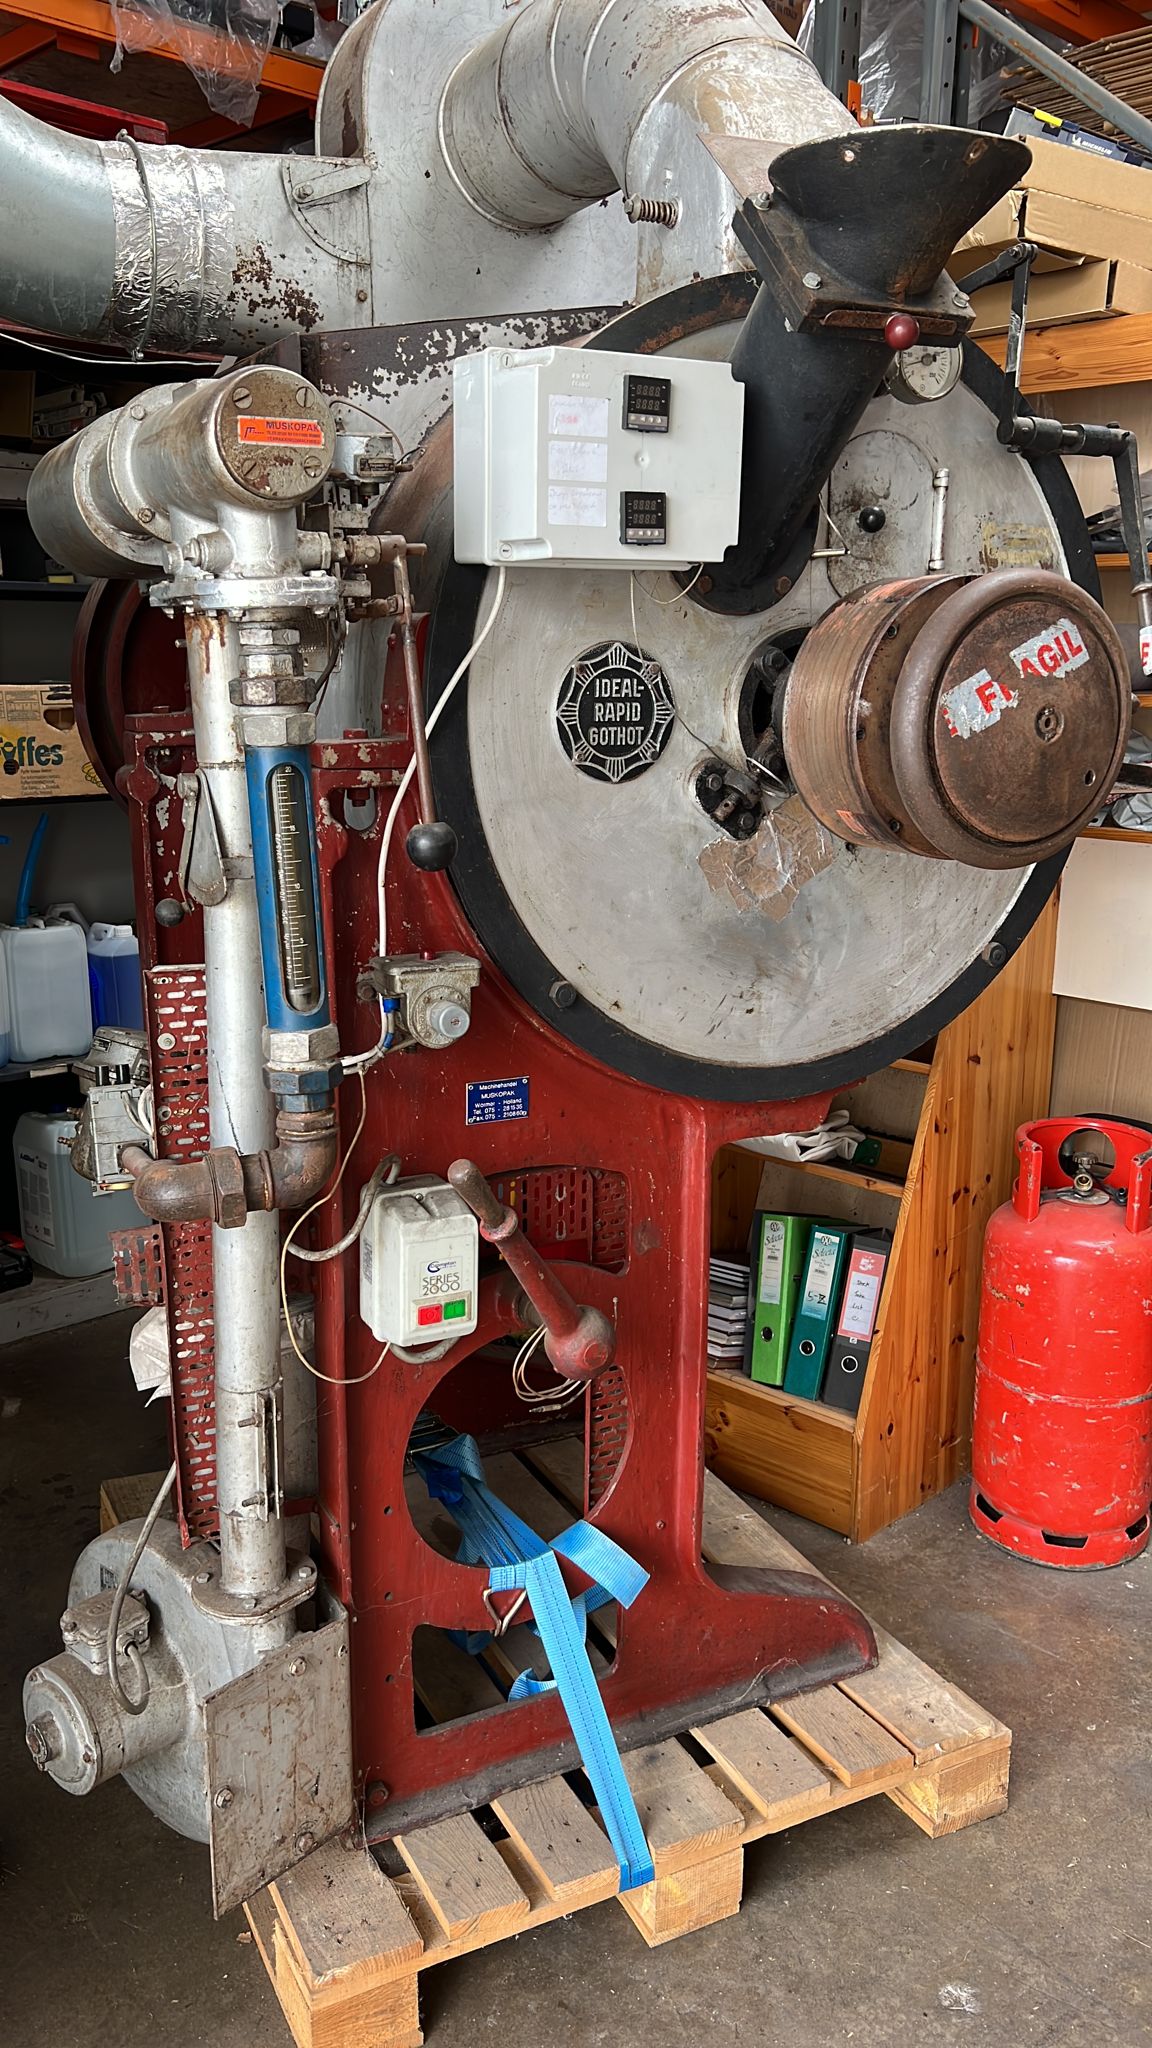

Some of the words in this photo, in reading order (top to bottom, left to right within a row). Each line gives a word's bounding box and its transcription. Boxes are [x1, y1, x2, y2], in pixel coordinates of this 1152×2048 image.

[1082, 140, 1113, 155] MICHELIN
[266, 421, 320, 432] MUSKOPAK
[594, 678, 645, 698] IDEAL-
[594, 702, 641, 722] RAPID
[589, 726, 645, 746] GOTHOT
[479, 1081, 518, 1090] Machinehandel
[481, 1090, 515, 1099] MUSKOPAK
[422, 1272, 460, 1287] SERIES
[422, 1281, 460, 1296] 2000
